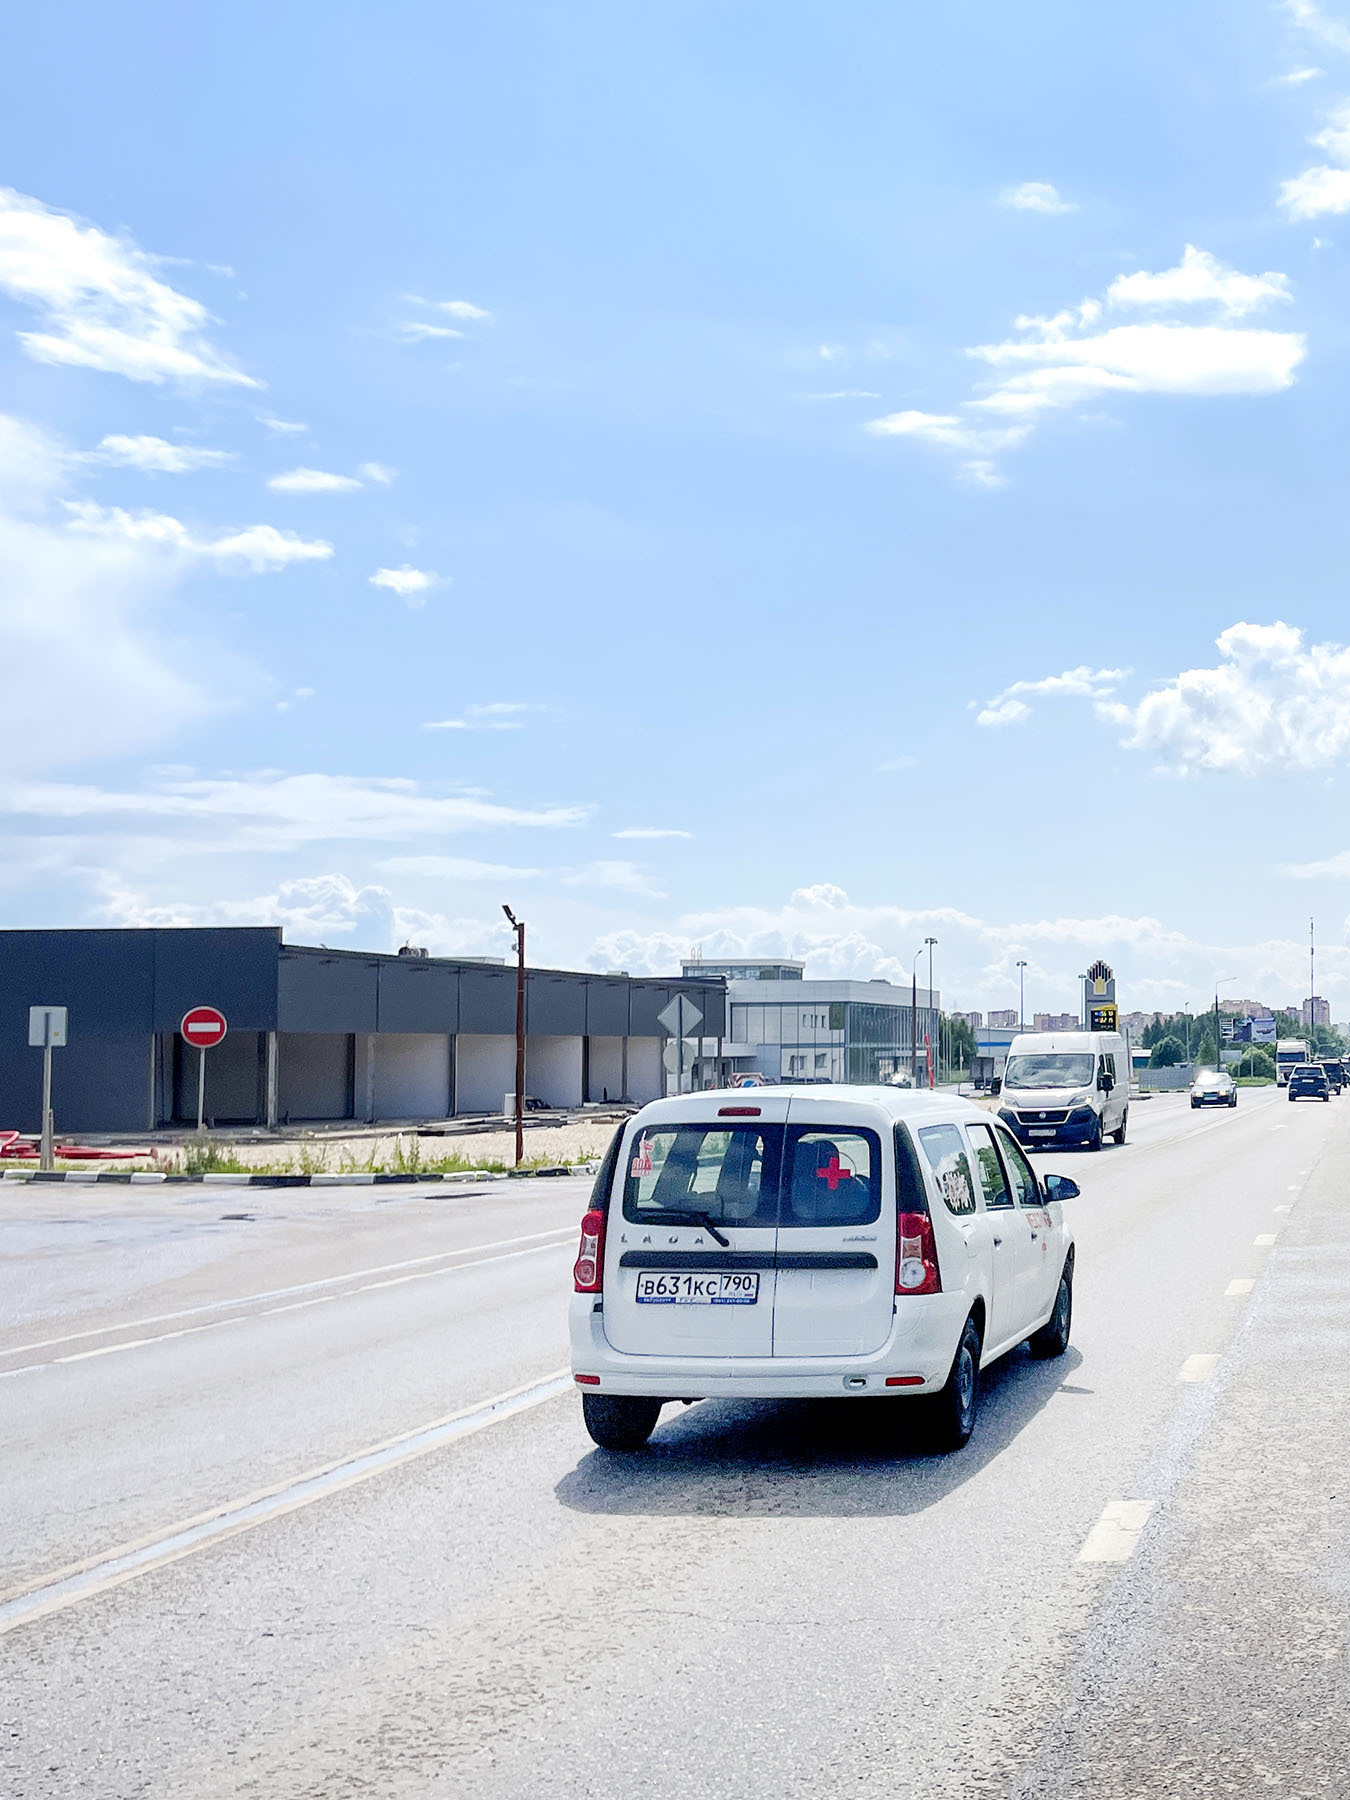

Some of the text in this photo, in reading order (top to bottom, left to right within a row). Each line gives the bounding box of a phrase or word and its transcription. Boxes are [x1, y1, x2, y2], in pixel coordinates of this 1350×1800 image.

[621, 1233, 704, 1244] LADA
[644, 1275, 752, 1296] В631КС 790
